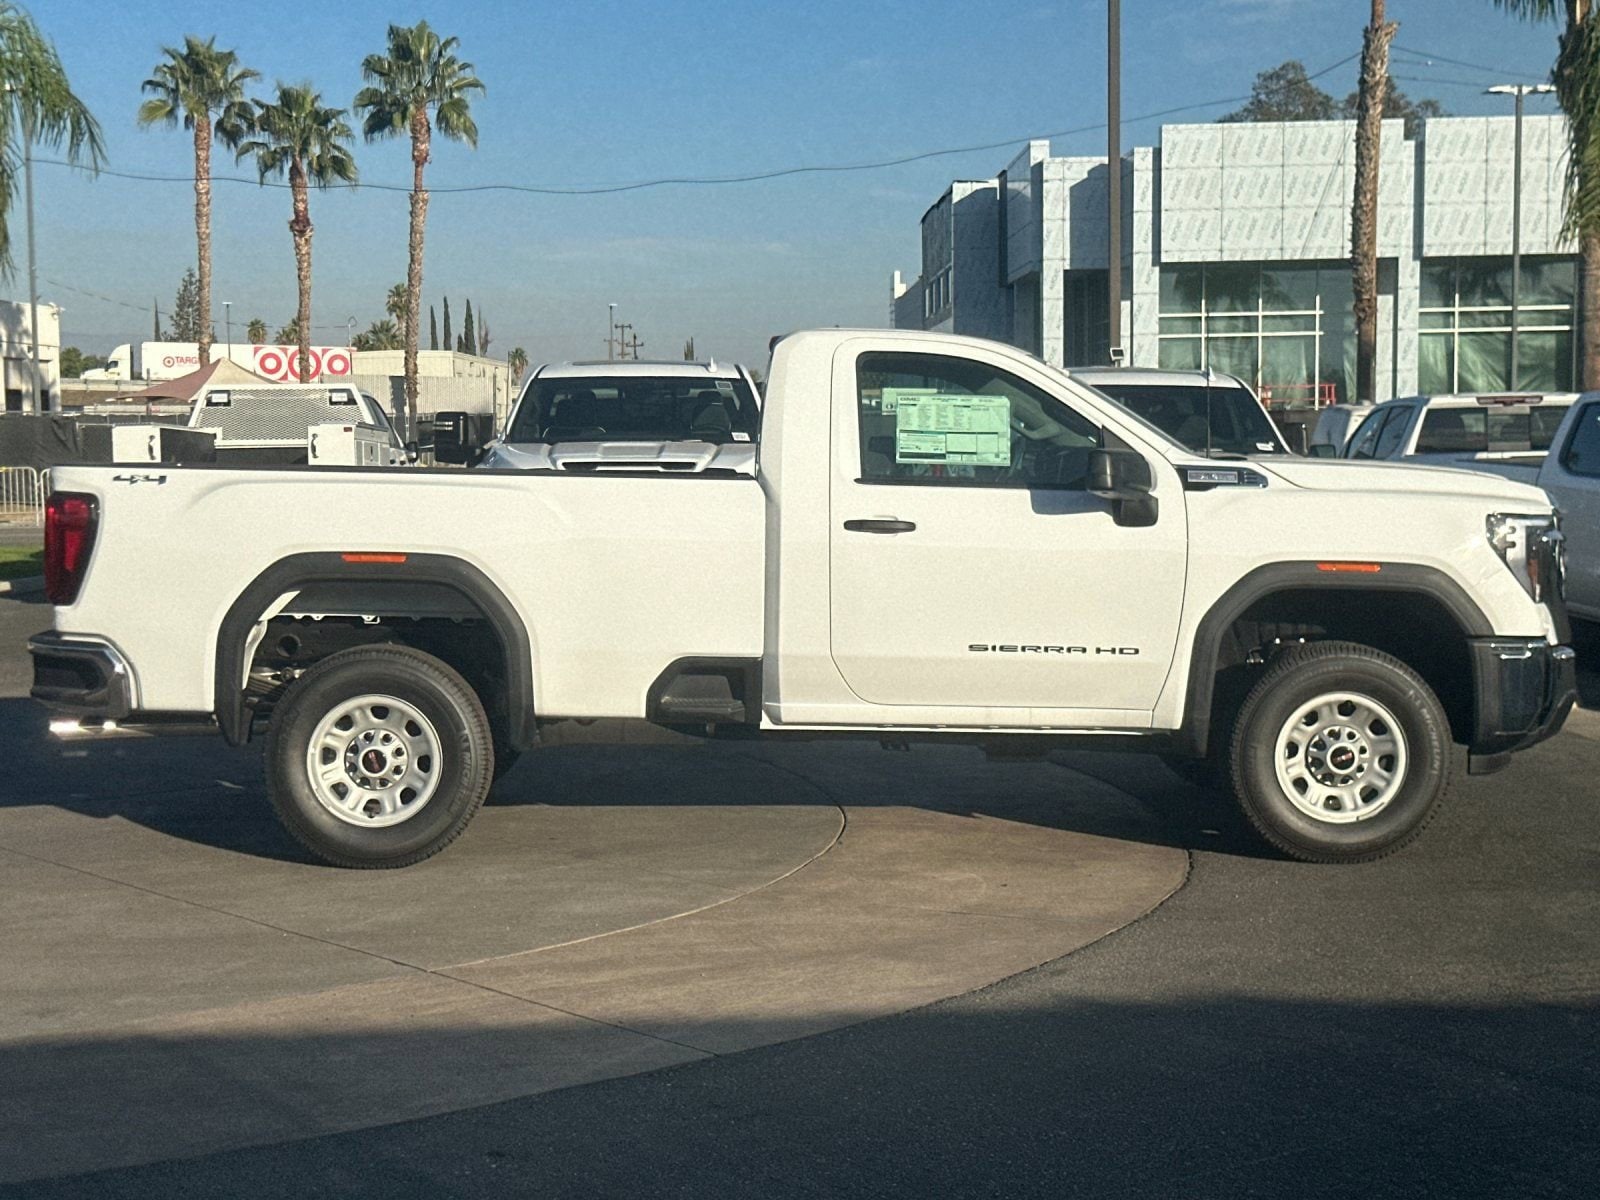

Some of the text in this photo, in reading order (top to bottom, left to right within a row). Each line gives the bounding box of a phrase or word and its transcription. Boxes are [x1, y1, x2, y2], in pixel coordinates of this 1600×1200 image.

[175, 356, 200, 365] TARG
[967, 644, 1140, 655] SIERRA HD
